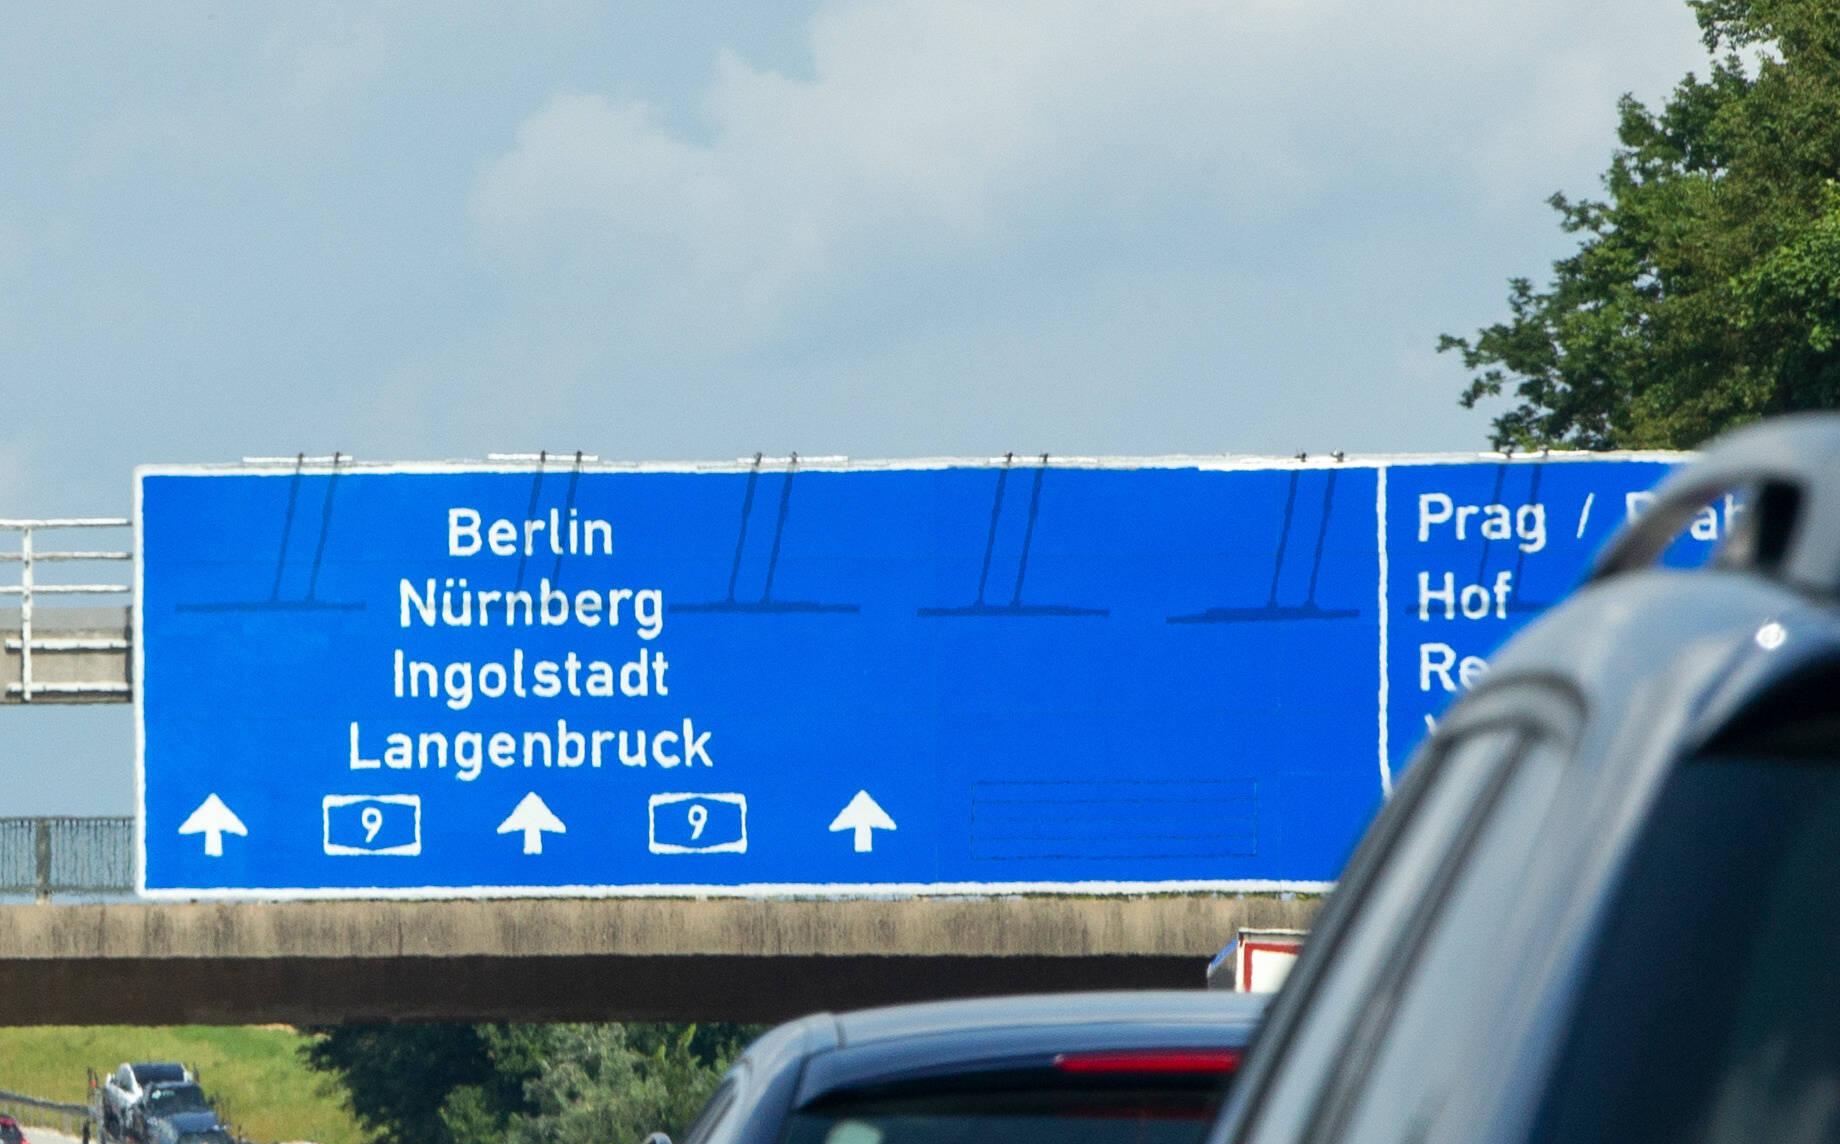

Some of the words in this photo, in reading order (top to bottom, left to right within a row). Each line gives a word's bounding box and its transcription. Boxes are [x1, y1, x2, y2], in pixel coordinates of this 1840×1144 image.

[448, 507, 613, 557] Berlin
[1418, 492, 1546, 553] Prag
[1576, 493, 1594, 540] /
[399, 578, 664, 640] Nürnberg
[1418, 570, 1512, 622] Hof
[394, 647, 669, 711] Ingolstadt
[349, 718, 713, 782] Langenbruck
[361, 807, 383, 844] 9
[687, 804, 708, 841] 9
